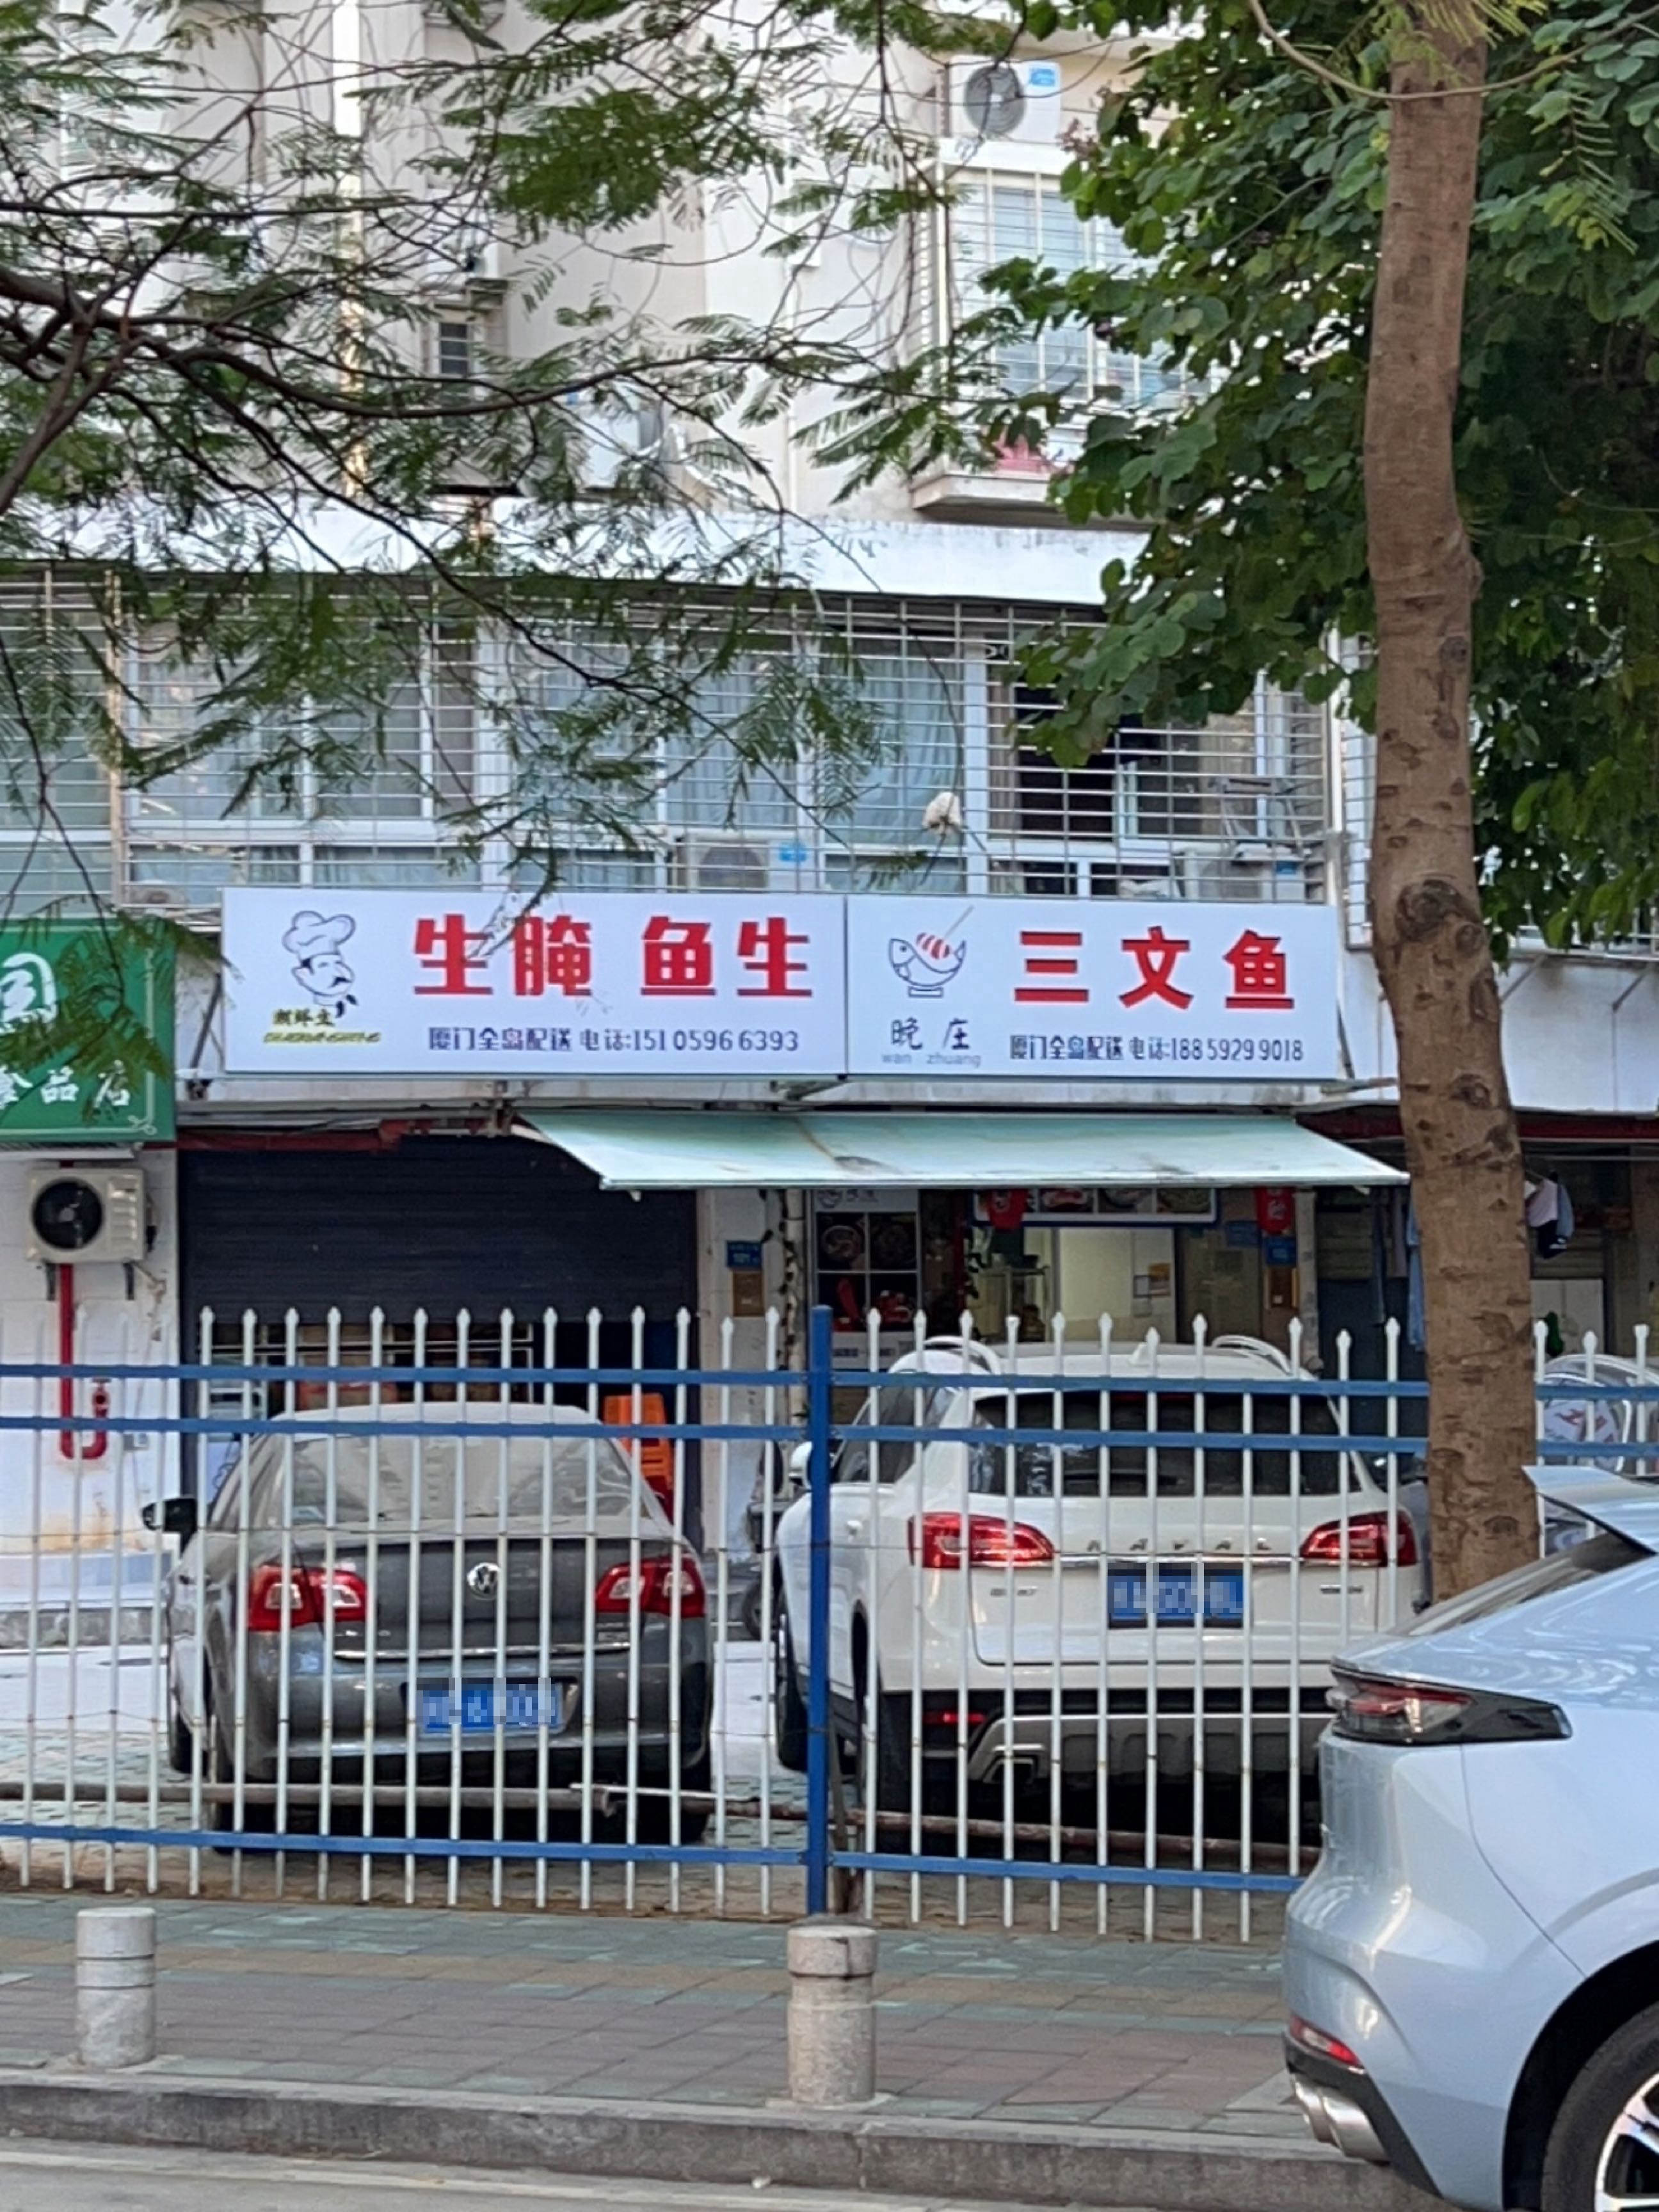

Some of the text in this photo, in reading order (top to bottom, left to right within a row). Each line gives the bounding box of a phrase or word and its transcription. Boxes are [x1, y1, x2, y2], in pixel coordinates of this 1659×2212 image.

[414, 914, 812, 997] 生腌 鱼生
[1014, 926, 1294, 1010] 三文鱼
